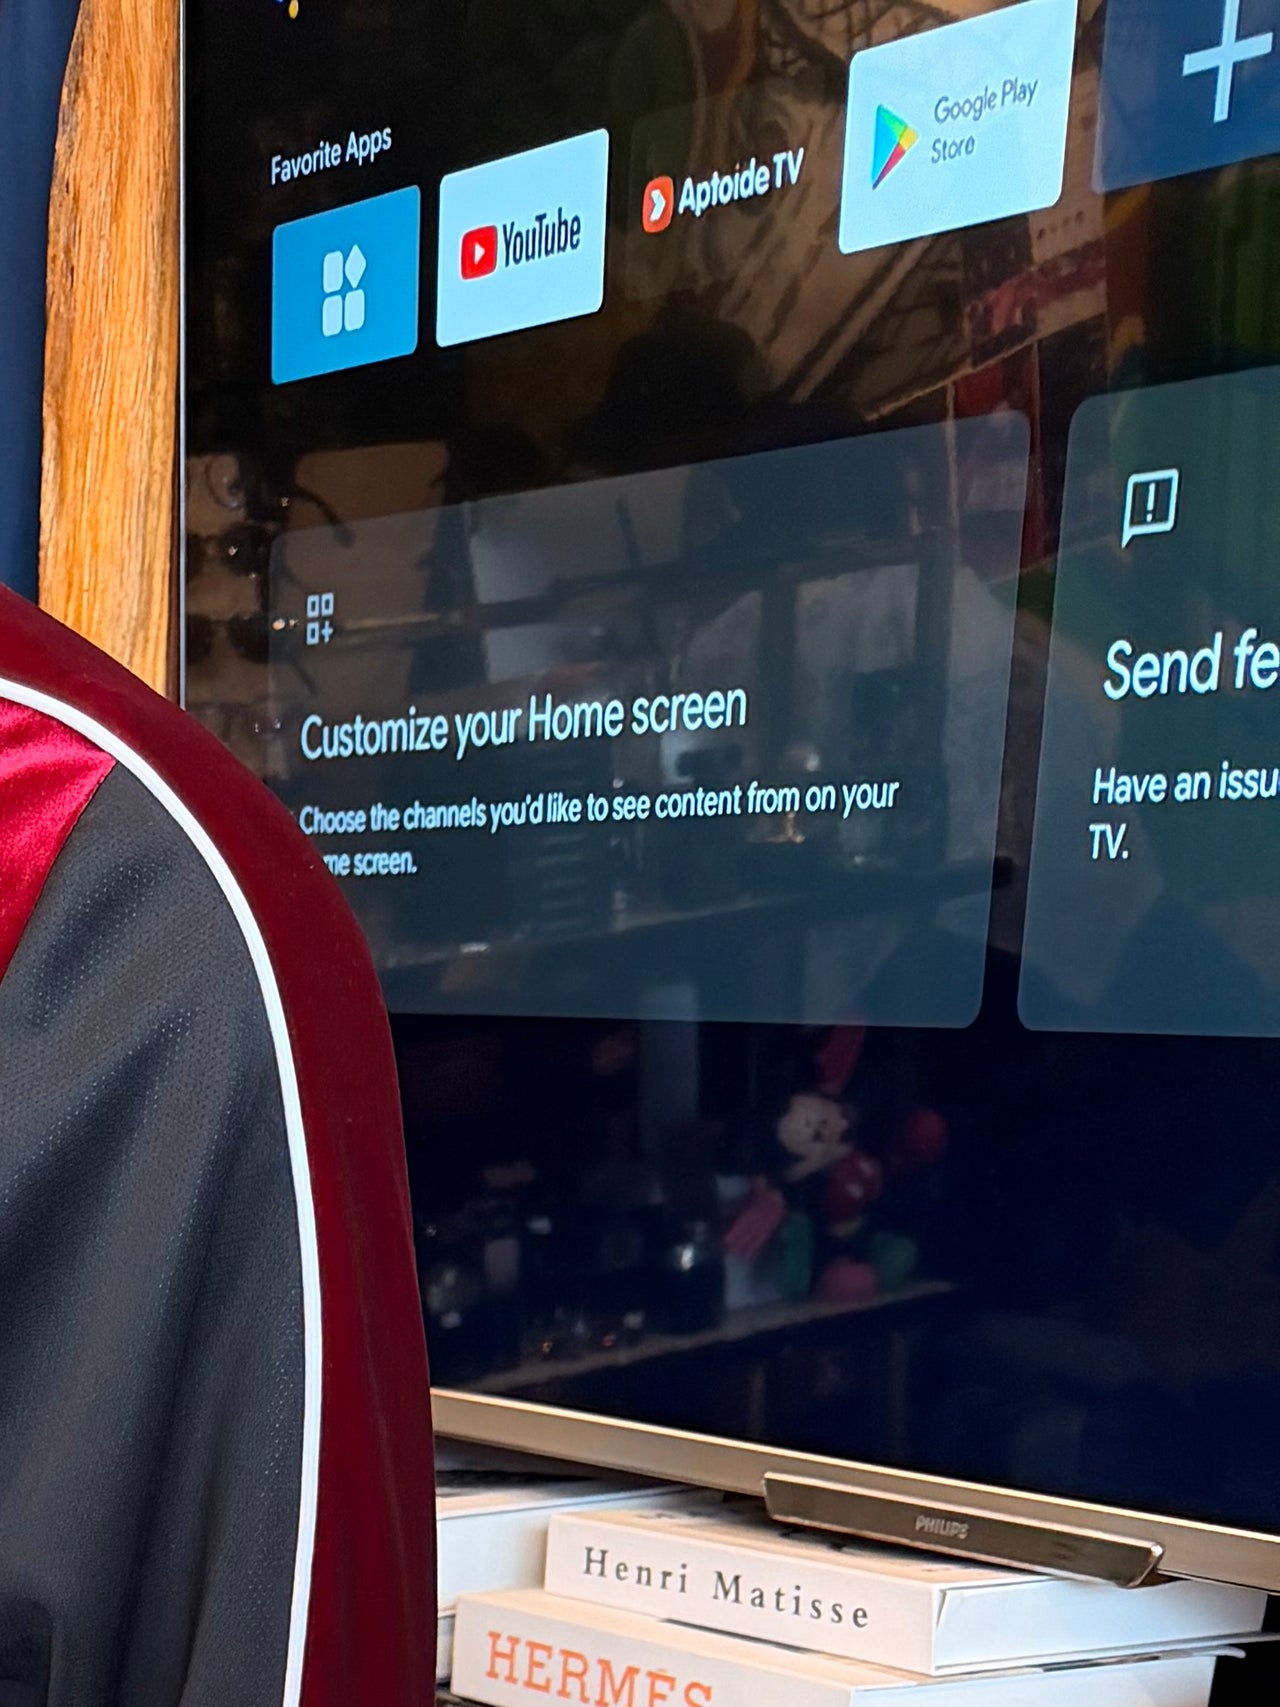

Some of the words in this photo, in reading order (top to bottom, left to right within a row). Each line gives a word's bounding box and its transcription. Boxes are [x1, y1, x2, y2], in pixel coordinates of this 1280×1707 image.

[934, 91, 997, 125] Google
[1001, 78, 1039, 108] Play
[271, 140, 342, 185] Favorite
[345, 127, 392, 167] Apps
[931, 136, 976, 164] Store
[679, 161, 770, 218] Aptoide
[773, 148, 805, 185] TV
[502, 207, 581, 267] YouTube
[1103, 632, 1223, 700] Send
[1234, 627, 1280, 690] fe
[300, 705, 449, 760] Customize
[454, 707, 523, 761] your
[527, 693, 623, 742] Home
[631, 688, 747, 735] screen
[298, 805, 367, 835] Choose
[370, 802, 400, 831] the
[403, 797, 487, 831] channels
[490, 793, 545, 834] you'd
[546, 792, 582, 823] like
[587, 793, 609, 822] to
[612, 795, 651, 821] see
[654, 784, 742, 819] content
[746, 781, 801, 815] from
[805, 784, 836, 812] on
[842, 781, 900, 819] your
[1093, 766, 1168, 804] Have
[1173, 770, 1211, 803] an
[1218, 760, 1280, 800] issu
[353, 850, 418, 876] screen.
[1089, 822, 1129, 860] TV.
[915, 1515, 970, 1540] PHILIPS
[583, 1546, 689, 1594] Henri
[712, 1570, 870, 1629] Matisse
